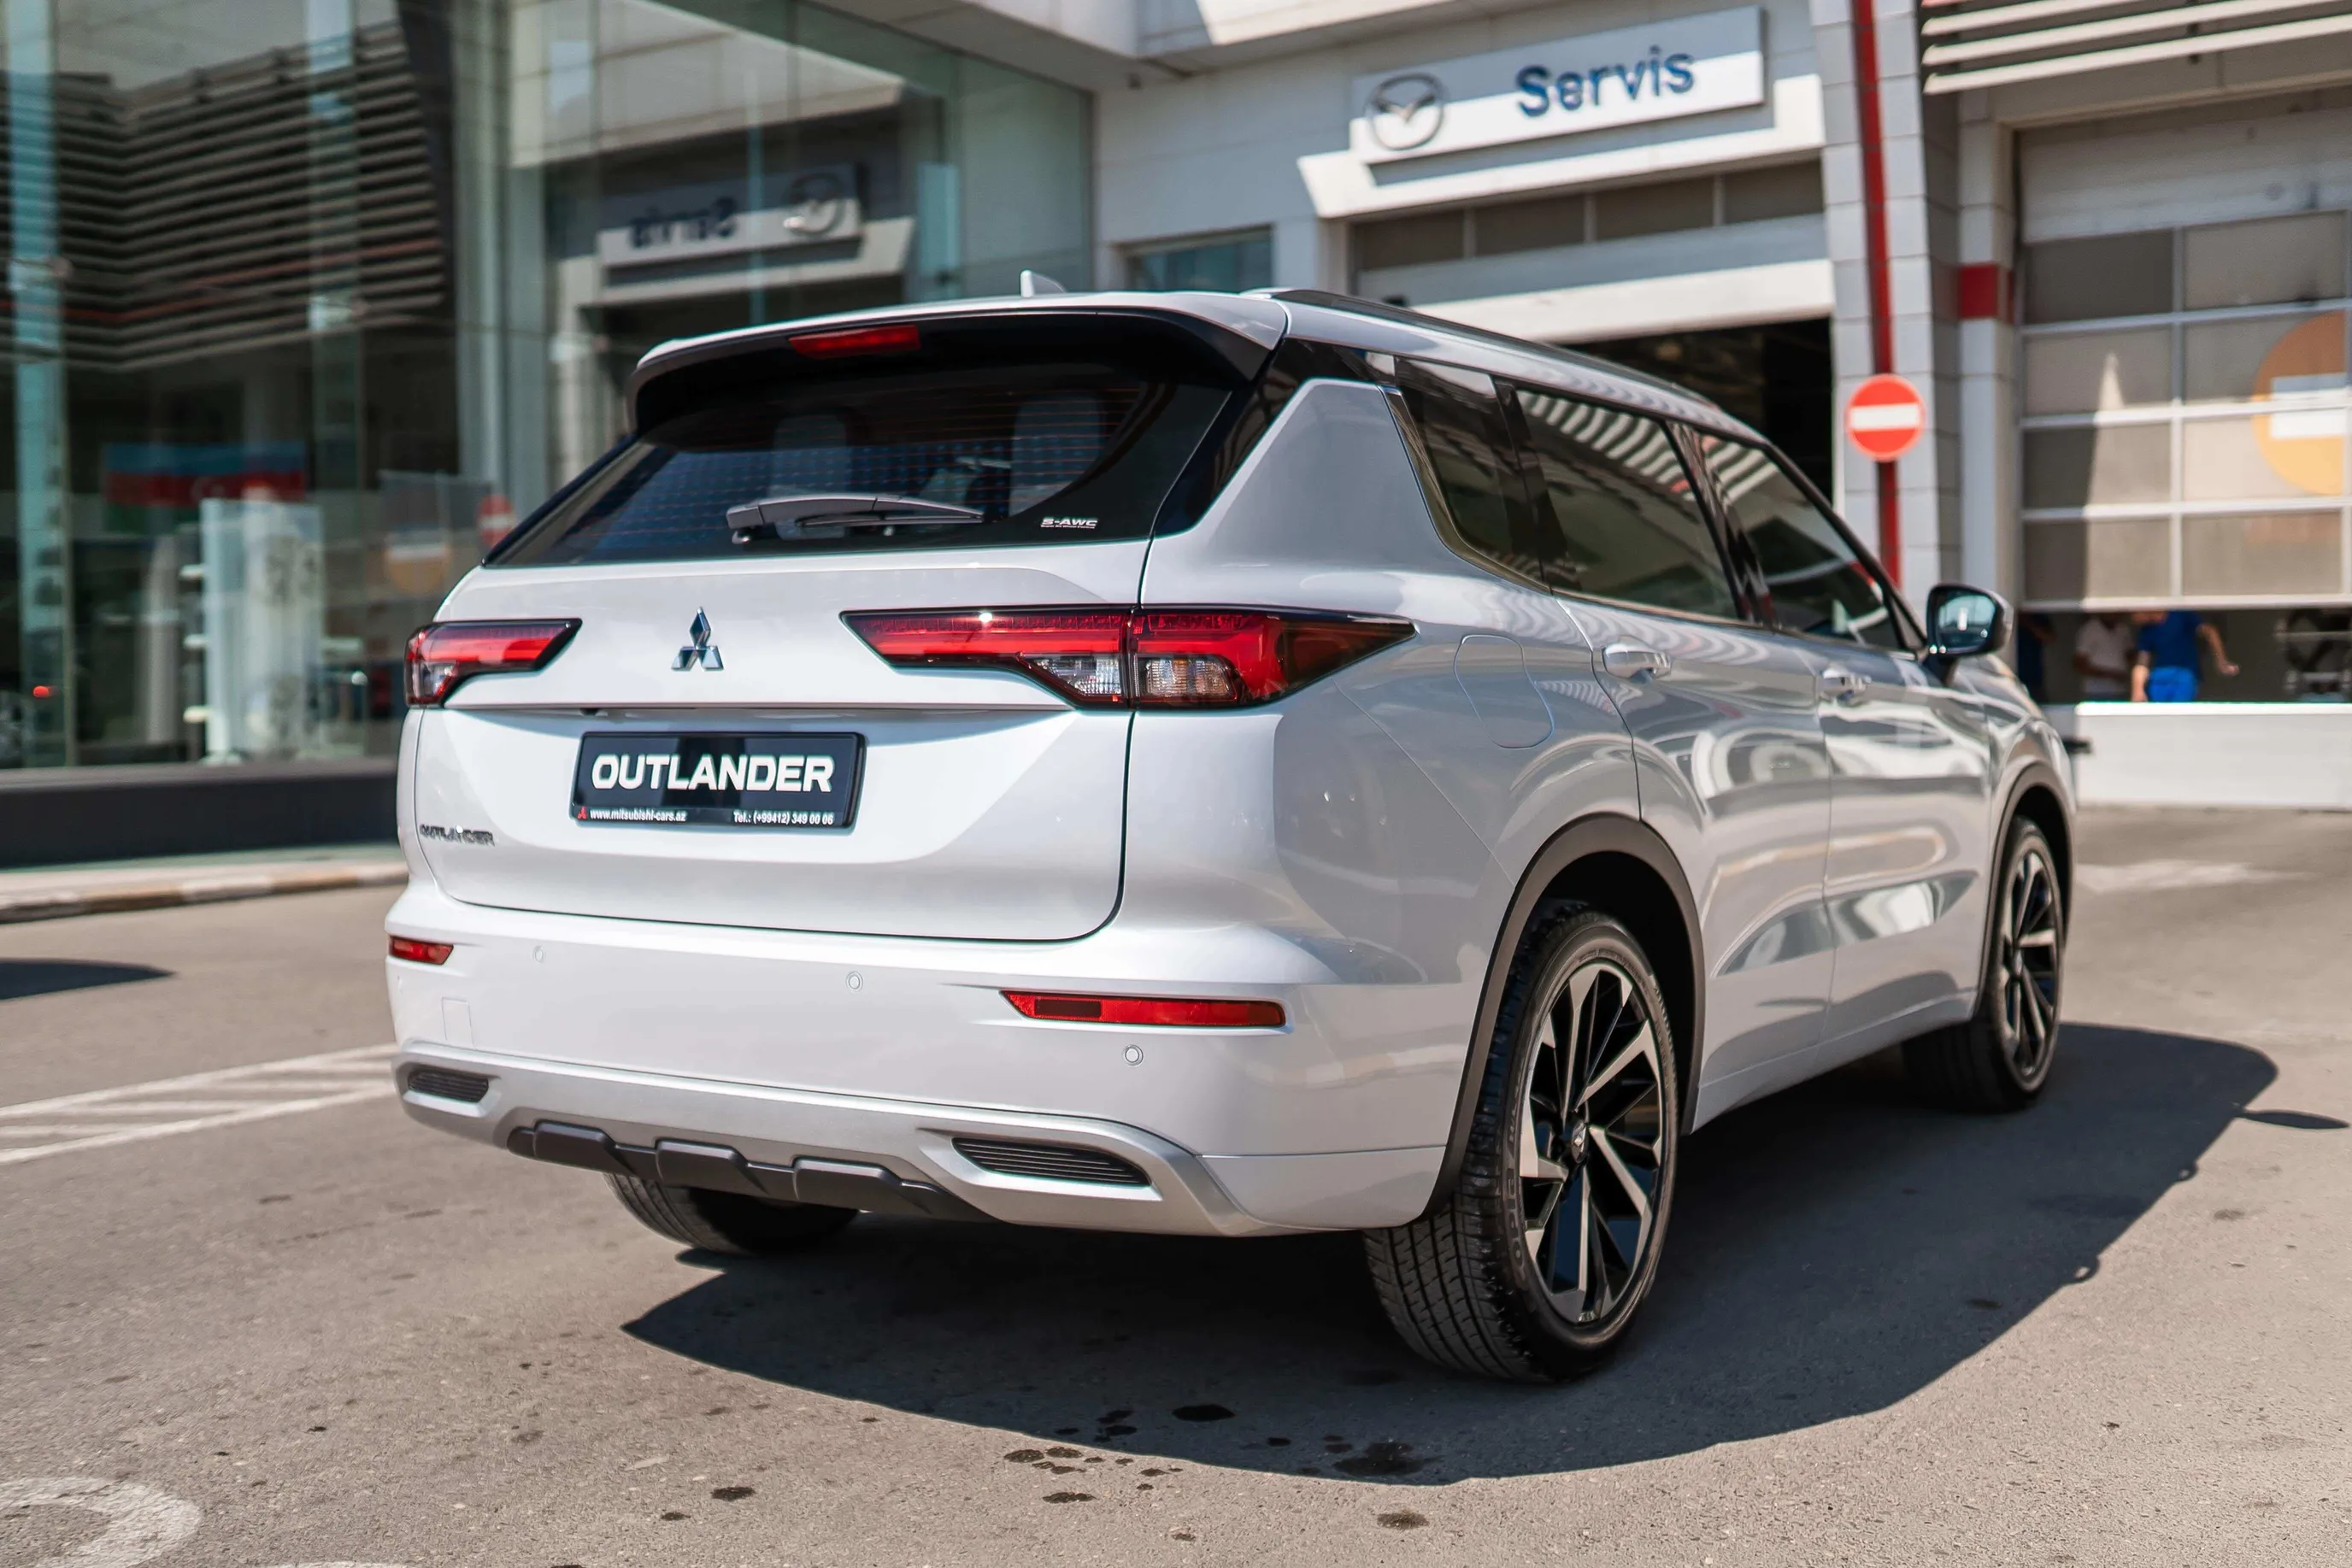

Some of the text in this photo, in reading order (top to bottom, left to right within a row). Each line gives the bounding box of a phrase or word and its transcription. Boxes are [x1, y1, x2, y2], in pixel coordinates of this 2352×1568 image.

[1516, 45, 1695, 116] Servis
[1042, 517, 1097, 526] S-AWC
[591, 755, 835, 791] OUTLANDER
[590, 807, 686, 821] www.mitsubishi-cars.az
[733, 810, 834, 825] Tel.: (+99412) 349 00 06
